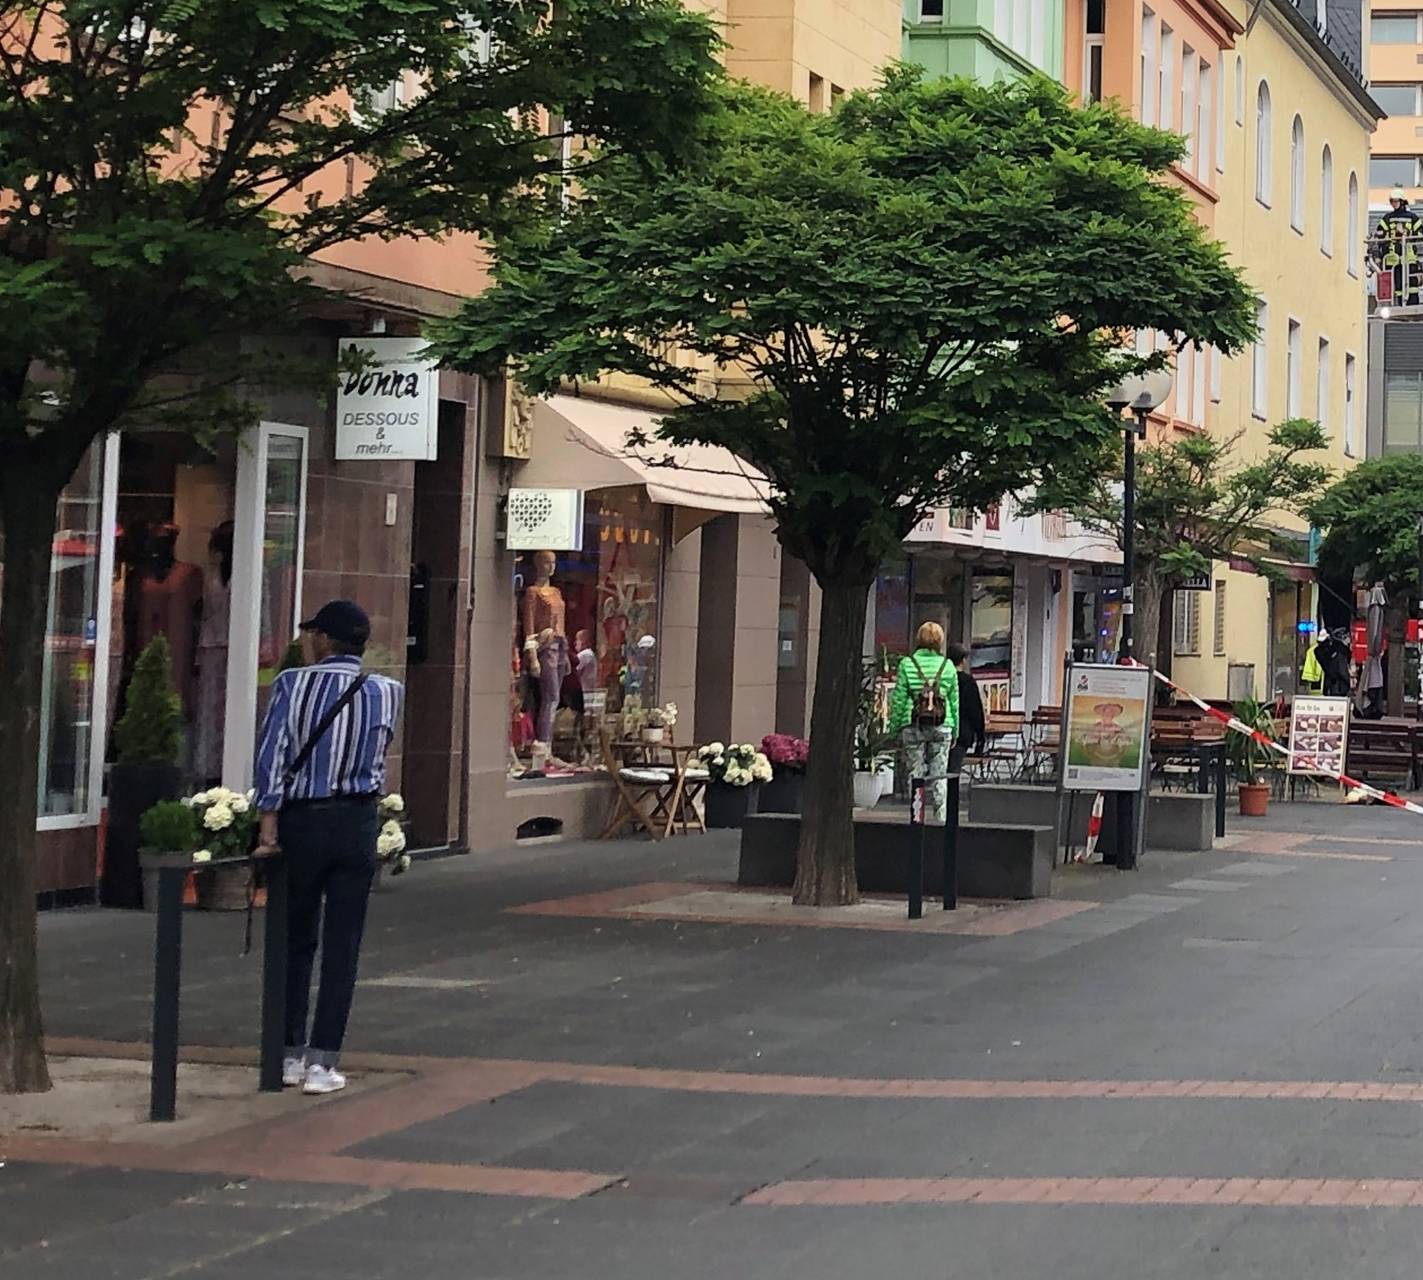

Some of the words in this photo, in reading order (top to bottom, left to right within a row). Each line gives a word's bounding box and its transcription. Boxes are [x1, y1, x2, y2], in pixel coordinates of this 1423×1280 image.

[342, 369, 420, 399] Donna
[343, 412, 420, 426] DESSOUS
[375, 426, 386, 440] &
